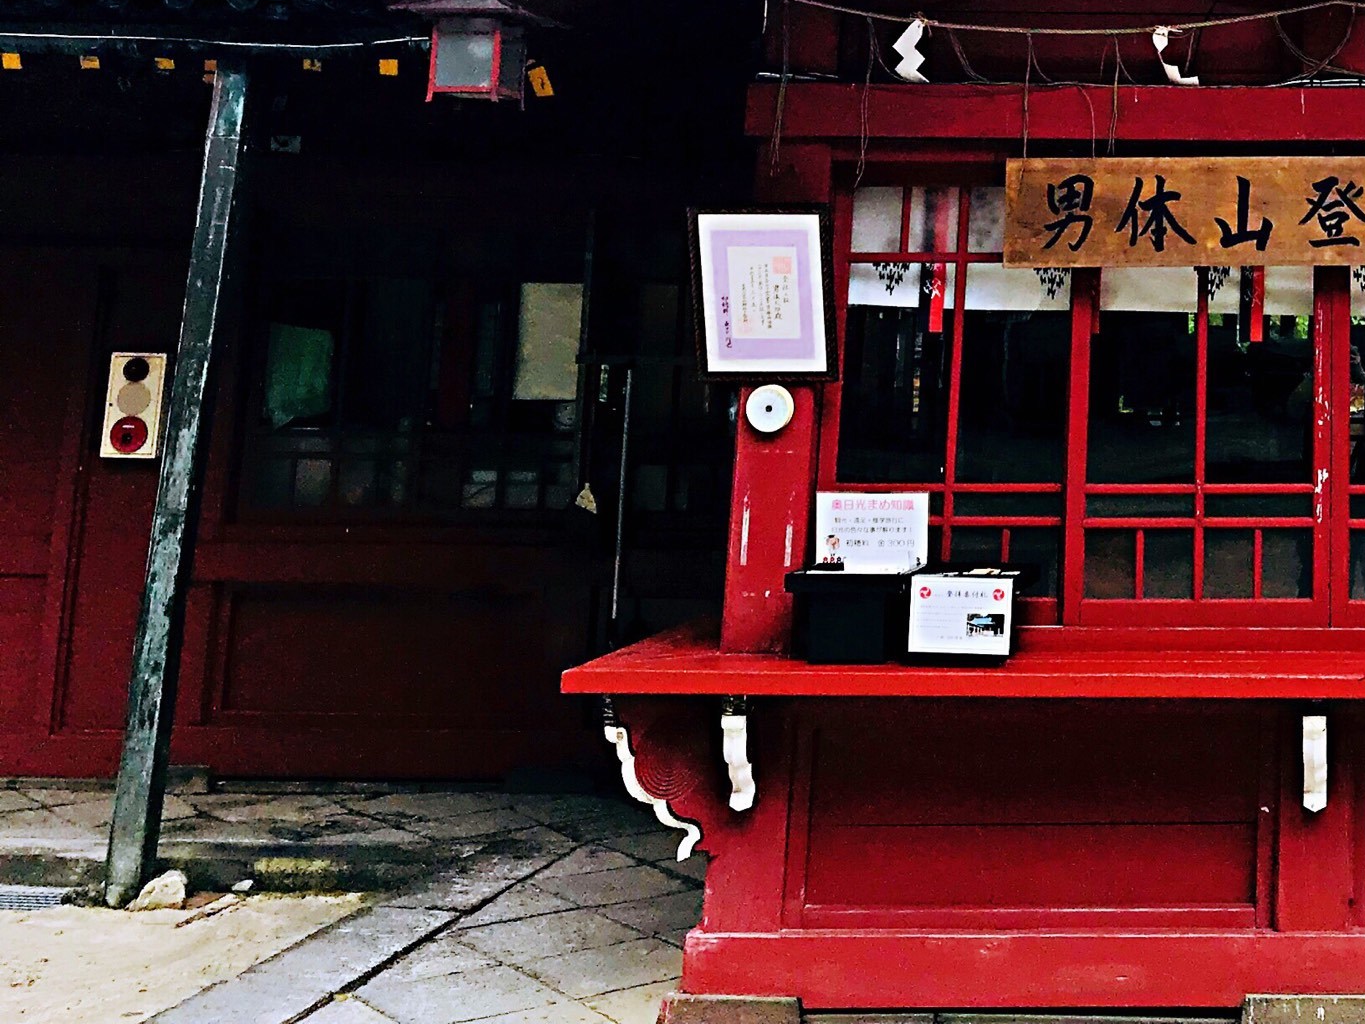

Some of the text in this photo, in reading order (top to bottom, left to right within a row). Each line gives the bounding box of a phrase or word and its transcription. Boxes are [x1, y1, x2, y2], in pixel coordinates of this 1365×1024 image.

[831, 499, 914, 511] 奥日光まめ知識
